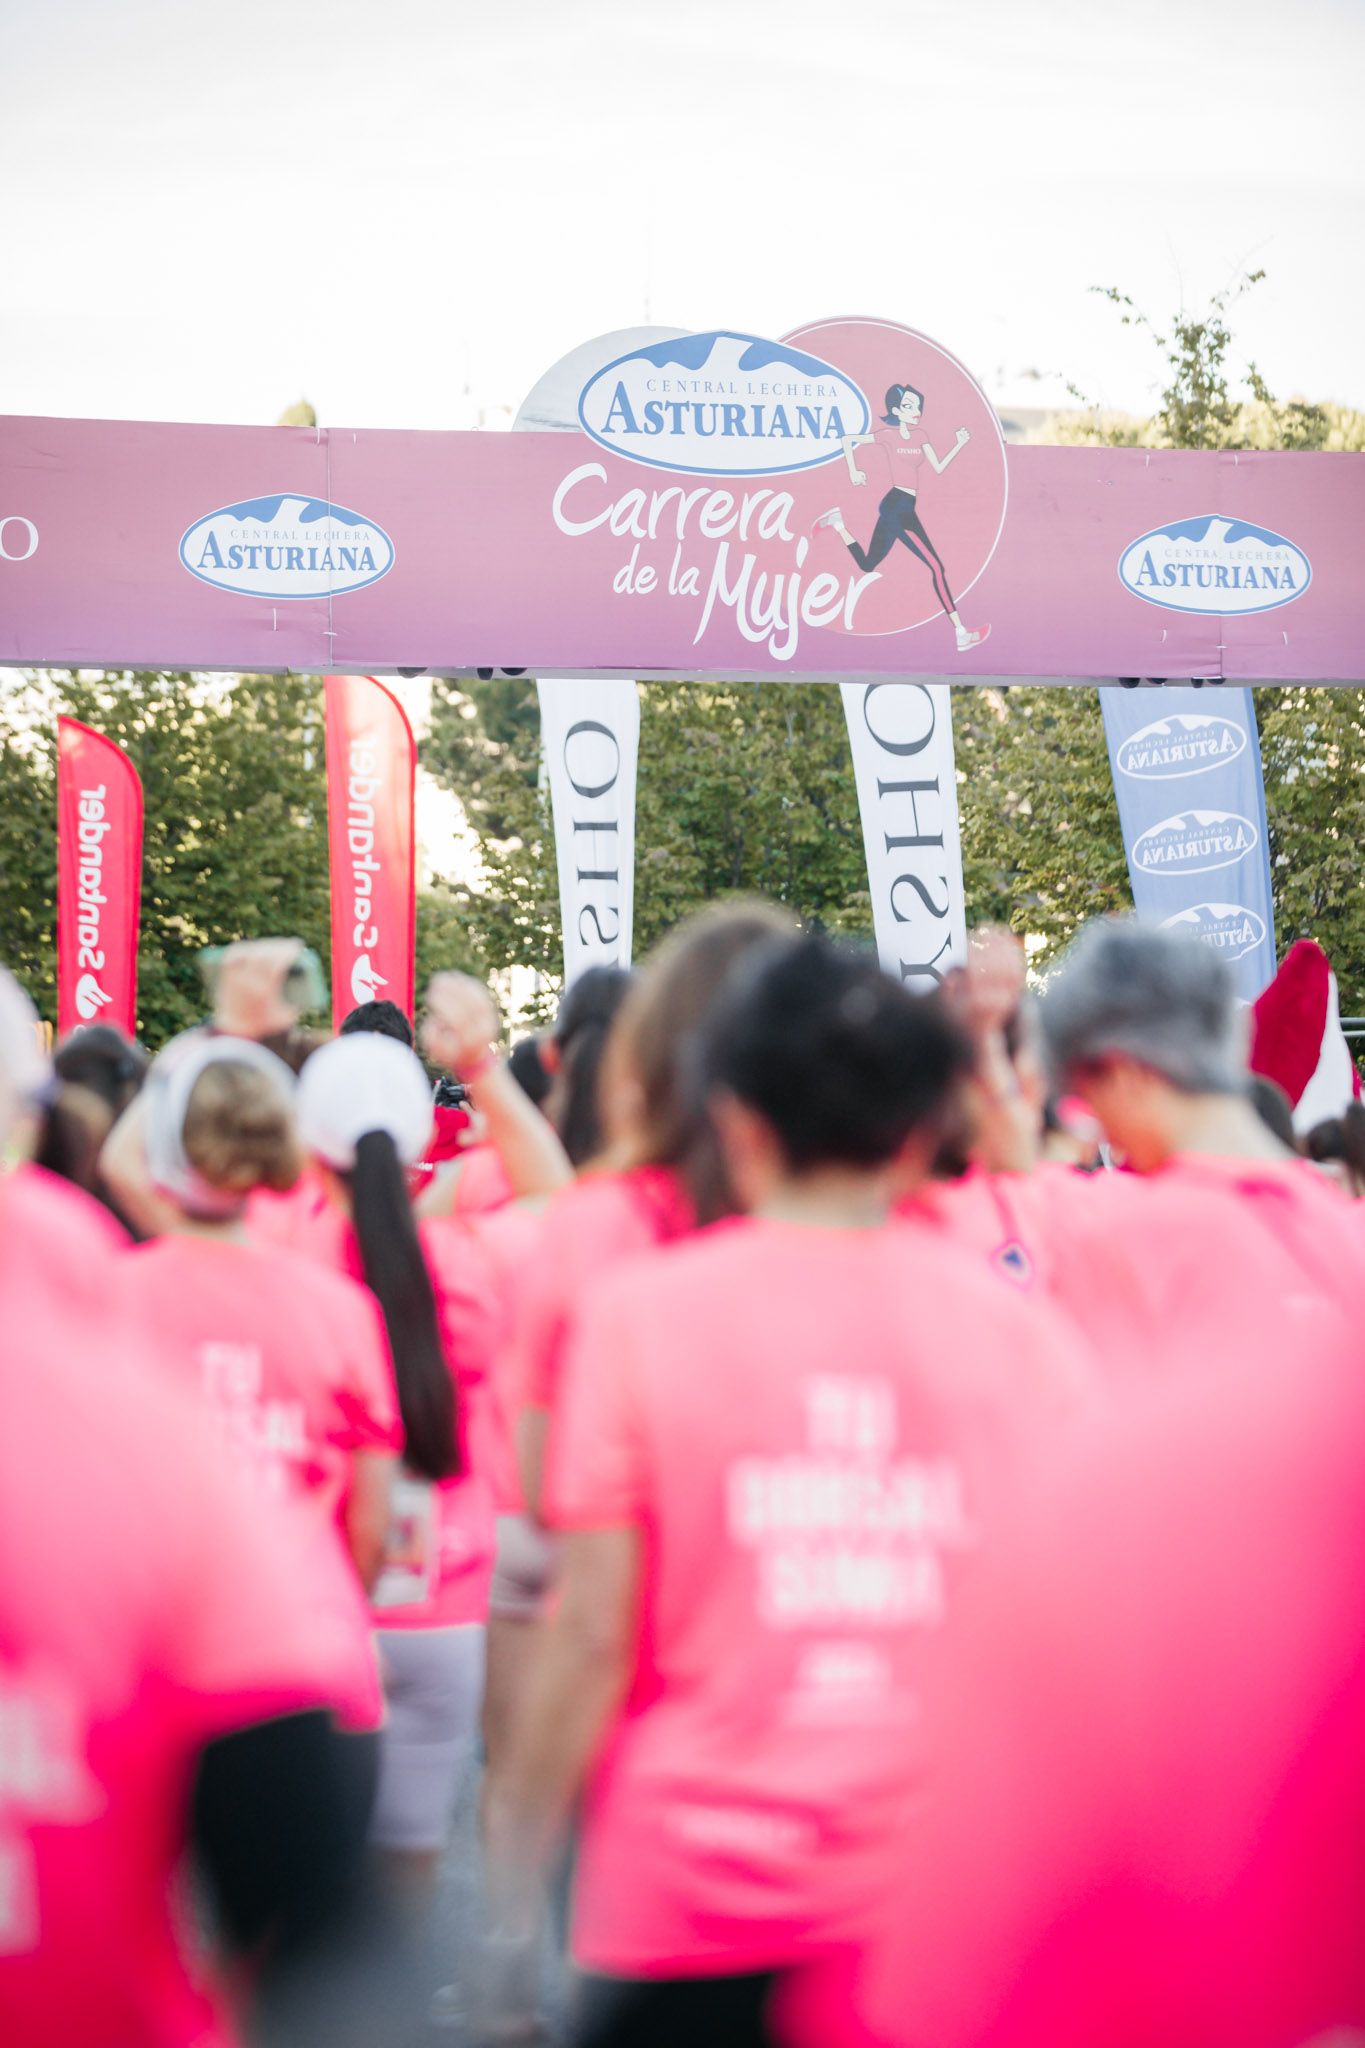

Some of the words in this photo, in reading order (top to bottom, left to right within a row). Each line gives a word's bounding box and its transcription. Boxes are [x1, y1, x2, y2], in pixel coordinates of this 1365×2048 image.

[646, 378, 737, 394] CENTRAL
[748, 382, 838, 397] LECHERA
[601, 380, 847, 440] ASTURIANA
[552, 462, 794, 541] Carrera
[197, 530, 378, 571] ASTURIANA
[230, 528, 298, 541] CENTRAL
[305, 530, 371, 542] LECHERA
[1164, 549, 1224, 560] CENTRA
[1229, 551, 1290, 561] LECHERA
[1135, 550, 1297, 589] ASTURIANA
[612, 543, 658, 594] de
[667, 541, 700, 596] la
[692, 536, 883, 661] Mujer
